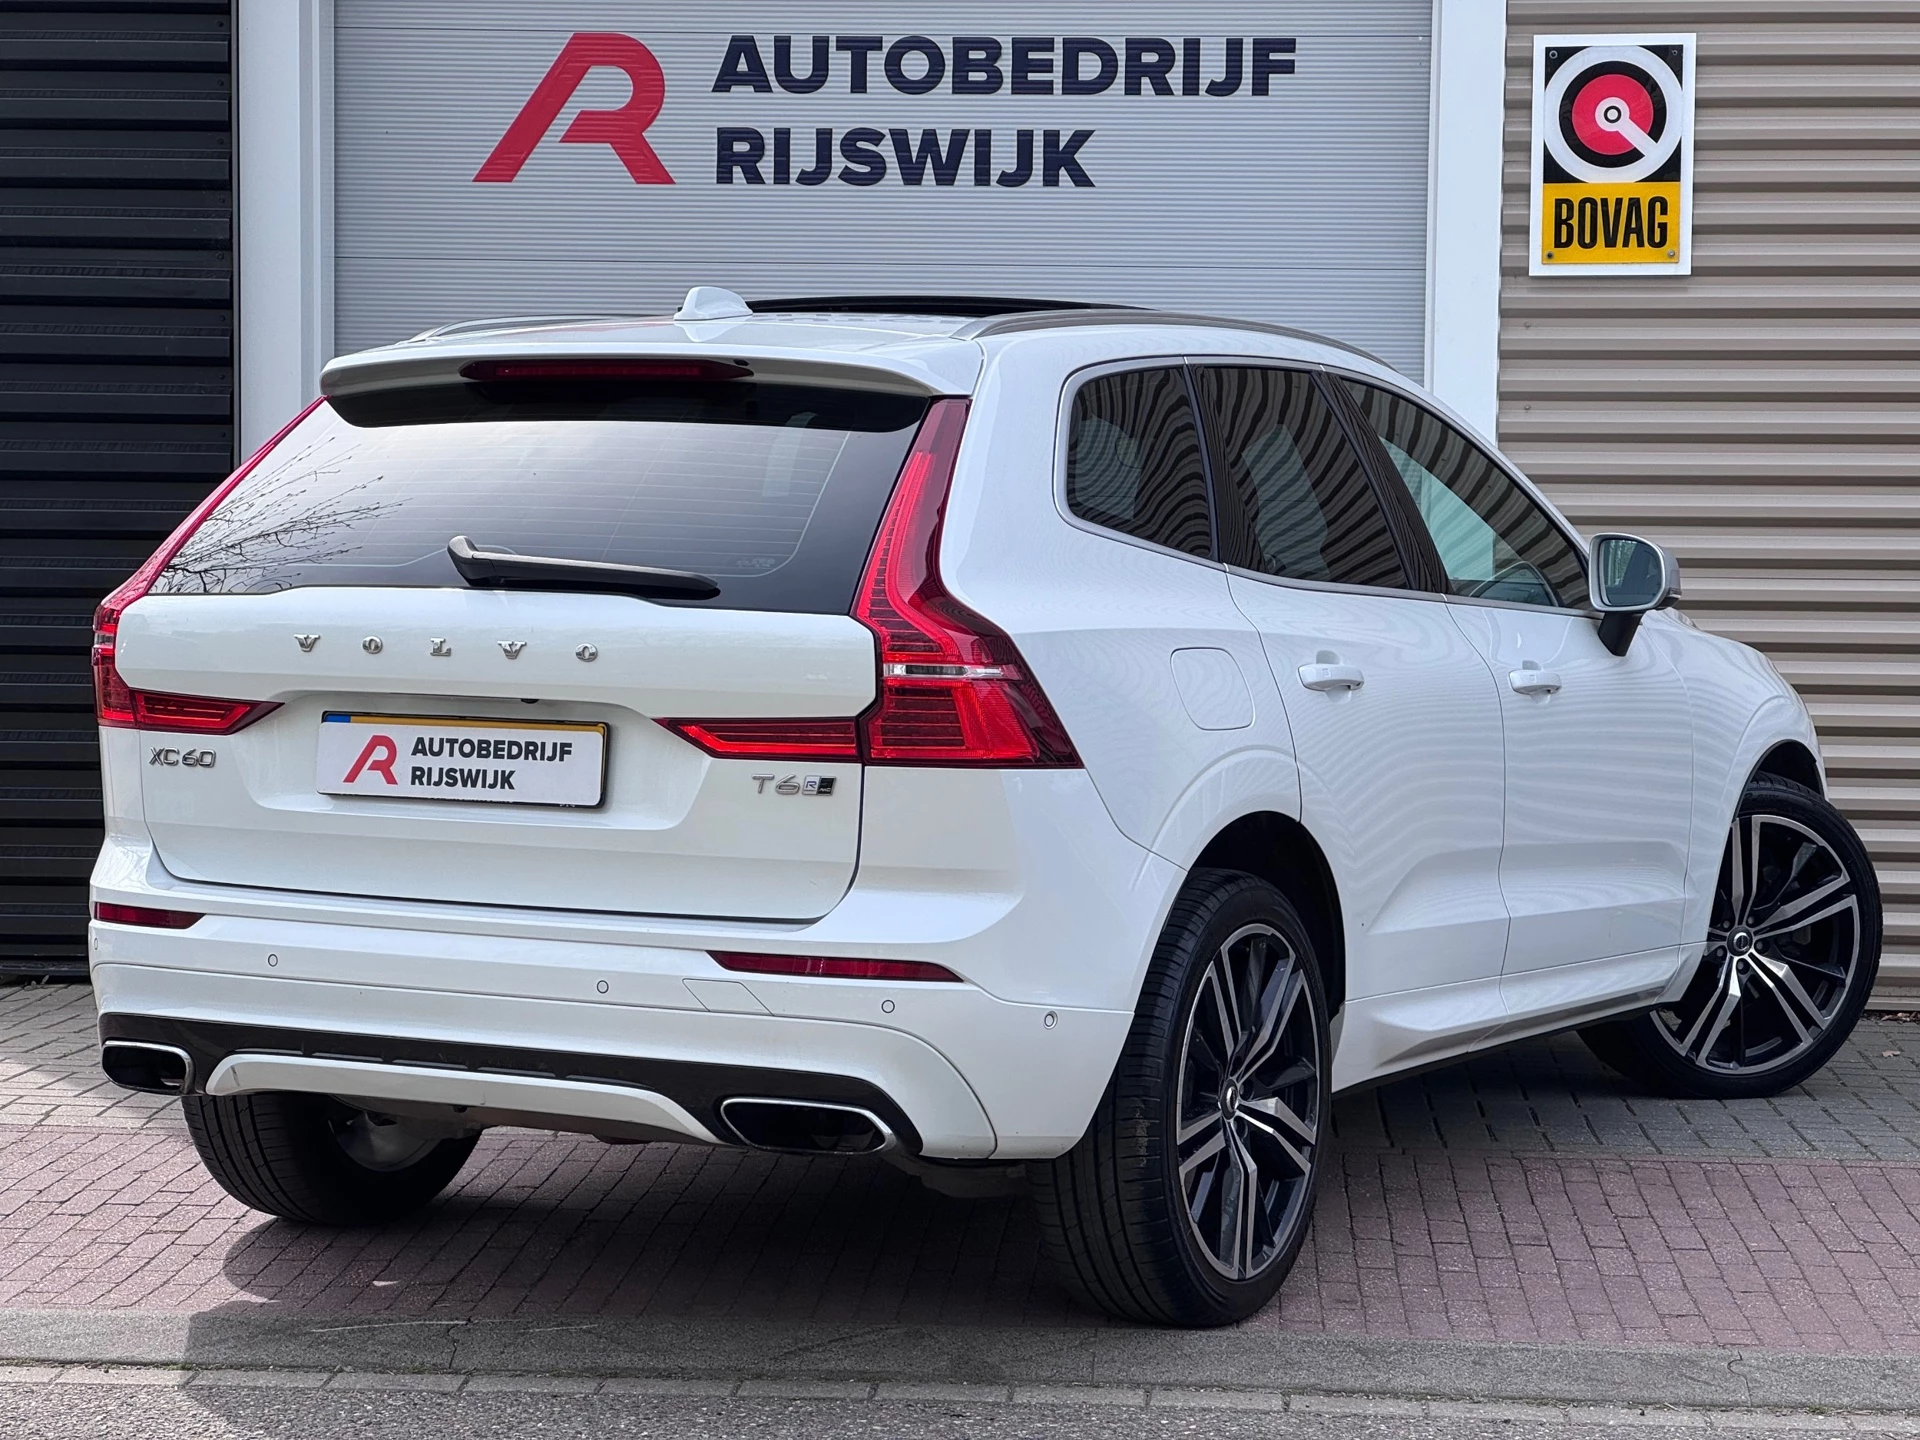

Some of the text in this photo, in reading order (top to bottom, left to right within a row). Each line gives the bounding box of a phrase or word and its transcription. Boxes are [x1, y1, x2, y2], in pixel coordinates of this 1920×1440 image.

[711, 35, 1296, 96] AUTOBEDRIJF
[715, 127, 1096, 187] RIJSWIJK
[1553, 196, 1669, 249] BOVAG
[294, 633, 599, 662] VOLVO
[149, 747, 217, 769] XC60
[411, 736, 573, 763] AUTOBEDRIJF
[410, 767, 516, 791] RIJSWIJK
[752, 774, 800, 795] T6
